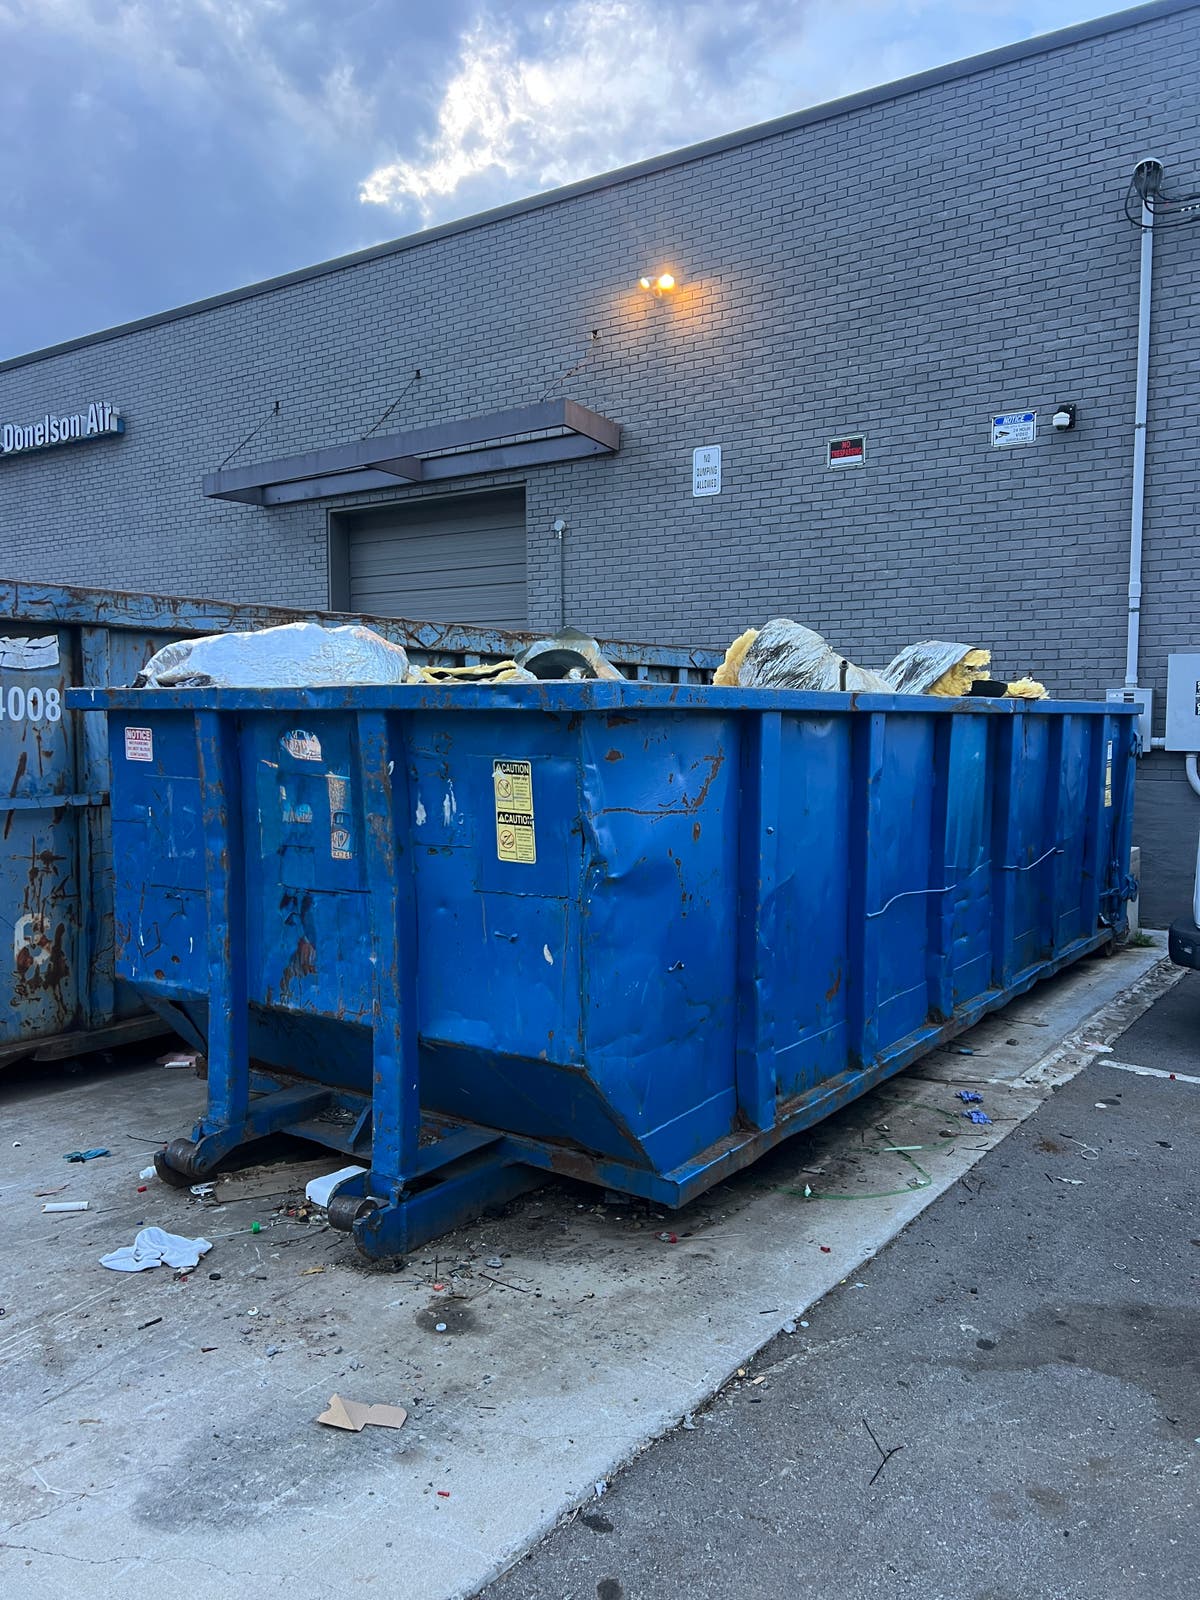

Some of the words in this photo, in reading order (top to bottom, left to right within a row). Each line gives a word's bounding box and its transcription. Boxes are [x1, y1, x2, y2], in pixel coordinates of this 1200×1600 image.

[1003, 415, 1025, 424] NOTICE
[4, 414, 80, 452] Donelson
[87, 402, 111, 434] Air
[841, 441, 850, 449] NO
[704, 454, 710, 463] NO
[697, 465, 718, 477] DUMPING
[697, 479, 717, 489] ALLOWED
[126, 729, 151, 740] NOTICE
[502, 763, 529, 774] CAUTION
[504, 814, 532, 825] CAUTION
